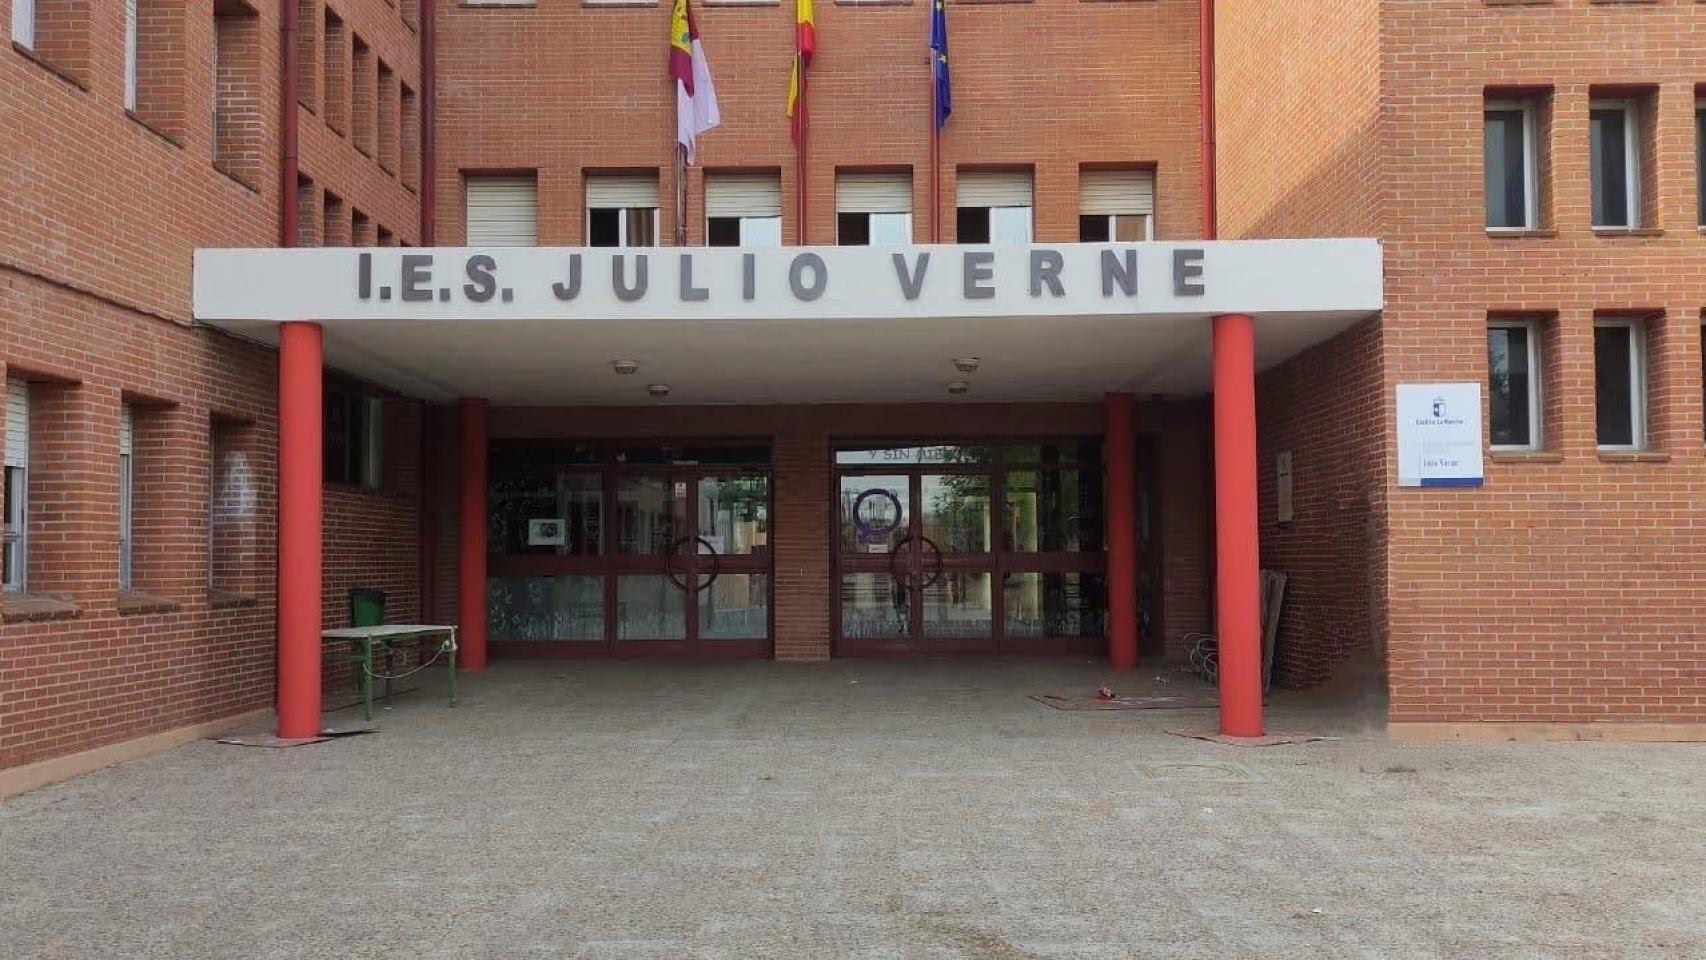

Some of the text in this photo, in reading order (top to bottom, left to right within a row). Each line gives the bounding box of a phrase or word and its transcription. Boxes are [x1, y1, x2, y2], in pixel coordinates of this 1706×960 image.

[359, 249, 1205, 301] I.E.S. JULIO VERNE
[884, 449, 909, 460] SIN
